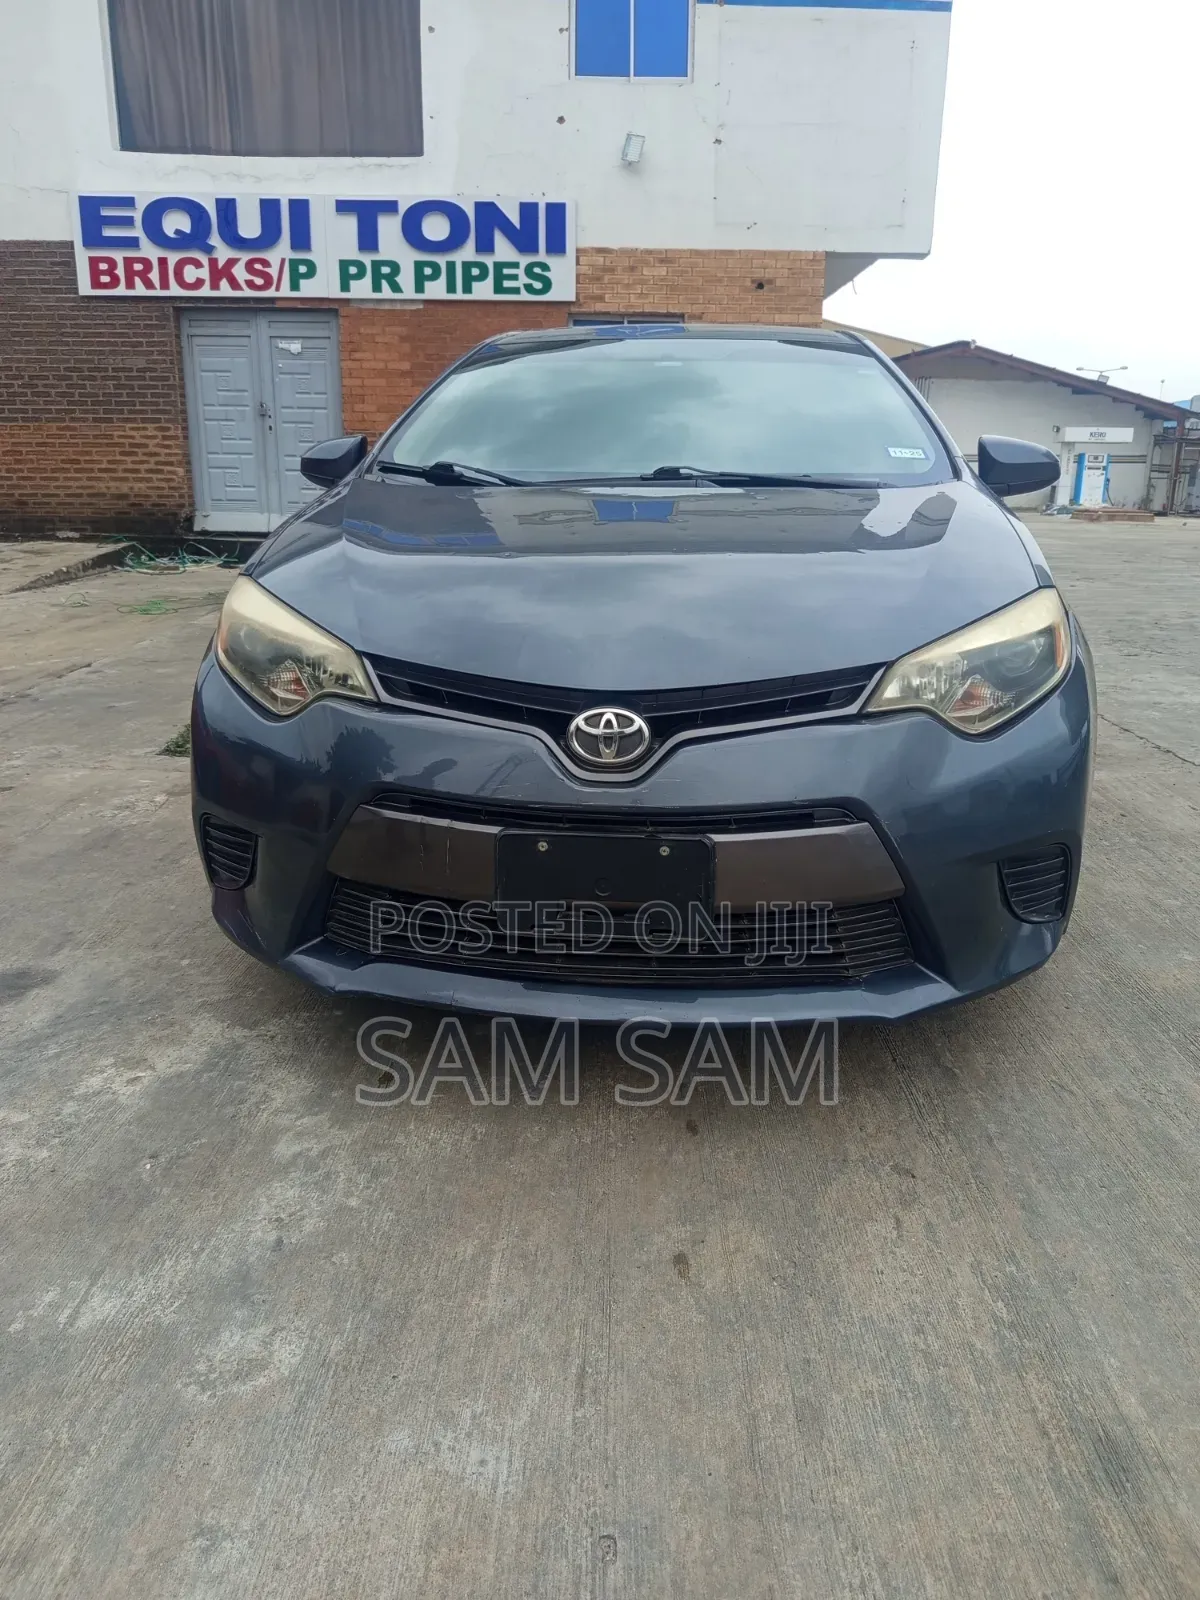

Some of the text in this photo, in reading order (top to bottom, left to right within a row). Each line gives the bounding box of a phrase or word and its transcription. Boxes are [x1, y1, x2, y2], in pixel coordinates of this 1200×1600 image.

[78, 195, 567, 255] EQUI TONI
[88, 256, 553, 295] BRICKS/P PR PIPES
